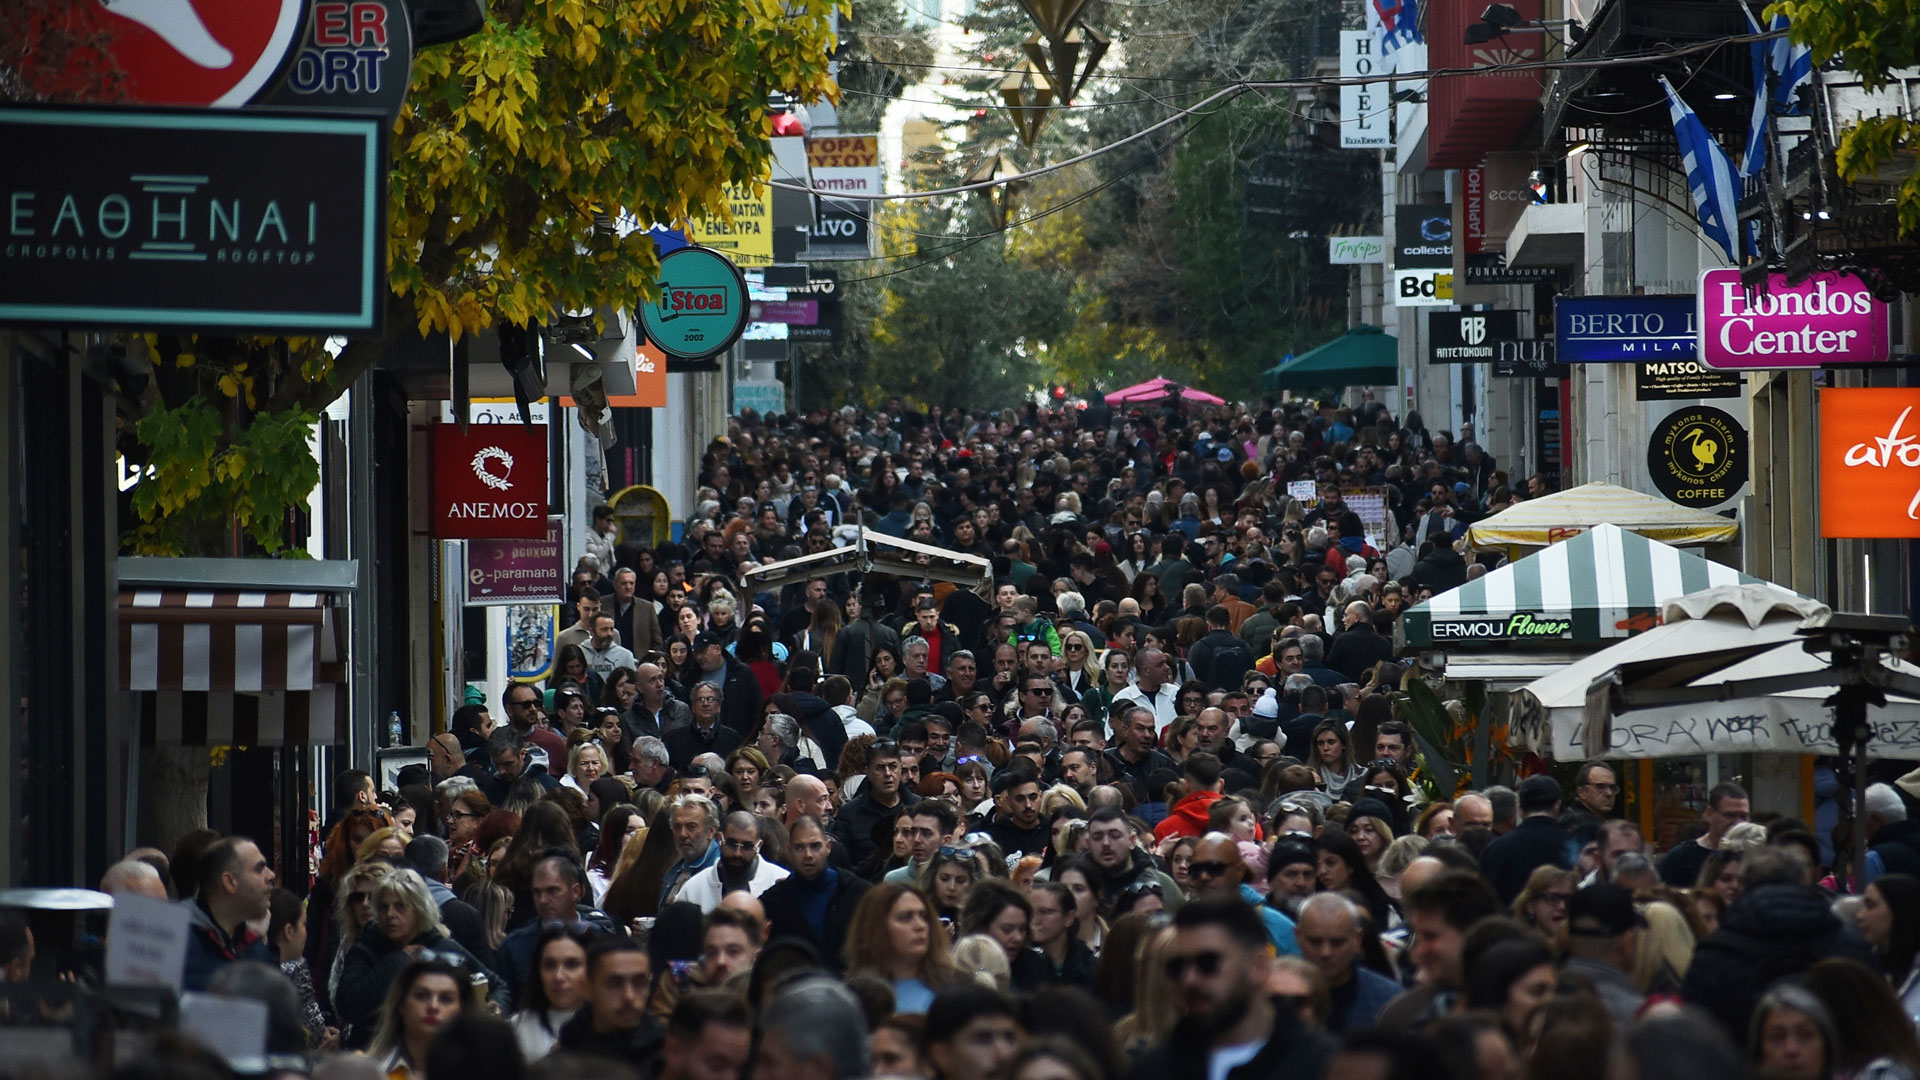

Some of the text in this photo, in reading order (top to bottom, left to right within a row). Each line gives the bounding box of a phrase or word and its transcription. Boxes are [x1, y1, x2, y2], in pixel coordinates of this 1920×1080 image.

[815, 177, 867, 190] oman
[1468, 197, 1480, 238] LAPIN
[1570, 313, 1664, 335] BERTO
[684, 334, 704, 342] 2002
[1720, 318, 1857, 355] Center
[1664, 415, 1734, 445] mykonos charm
[1667, 460, 1733, 485] mykonos charm
[1676, 488, 1726, 499] COFFEE
[447, 502, 538, 519] ΑΝΕΜΟΣ
[470, 568, 557, 585] e-paramana
[1432, 614, 1570, 637] ERMOU Flower
